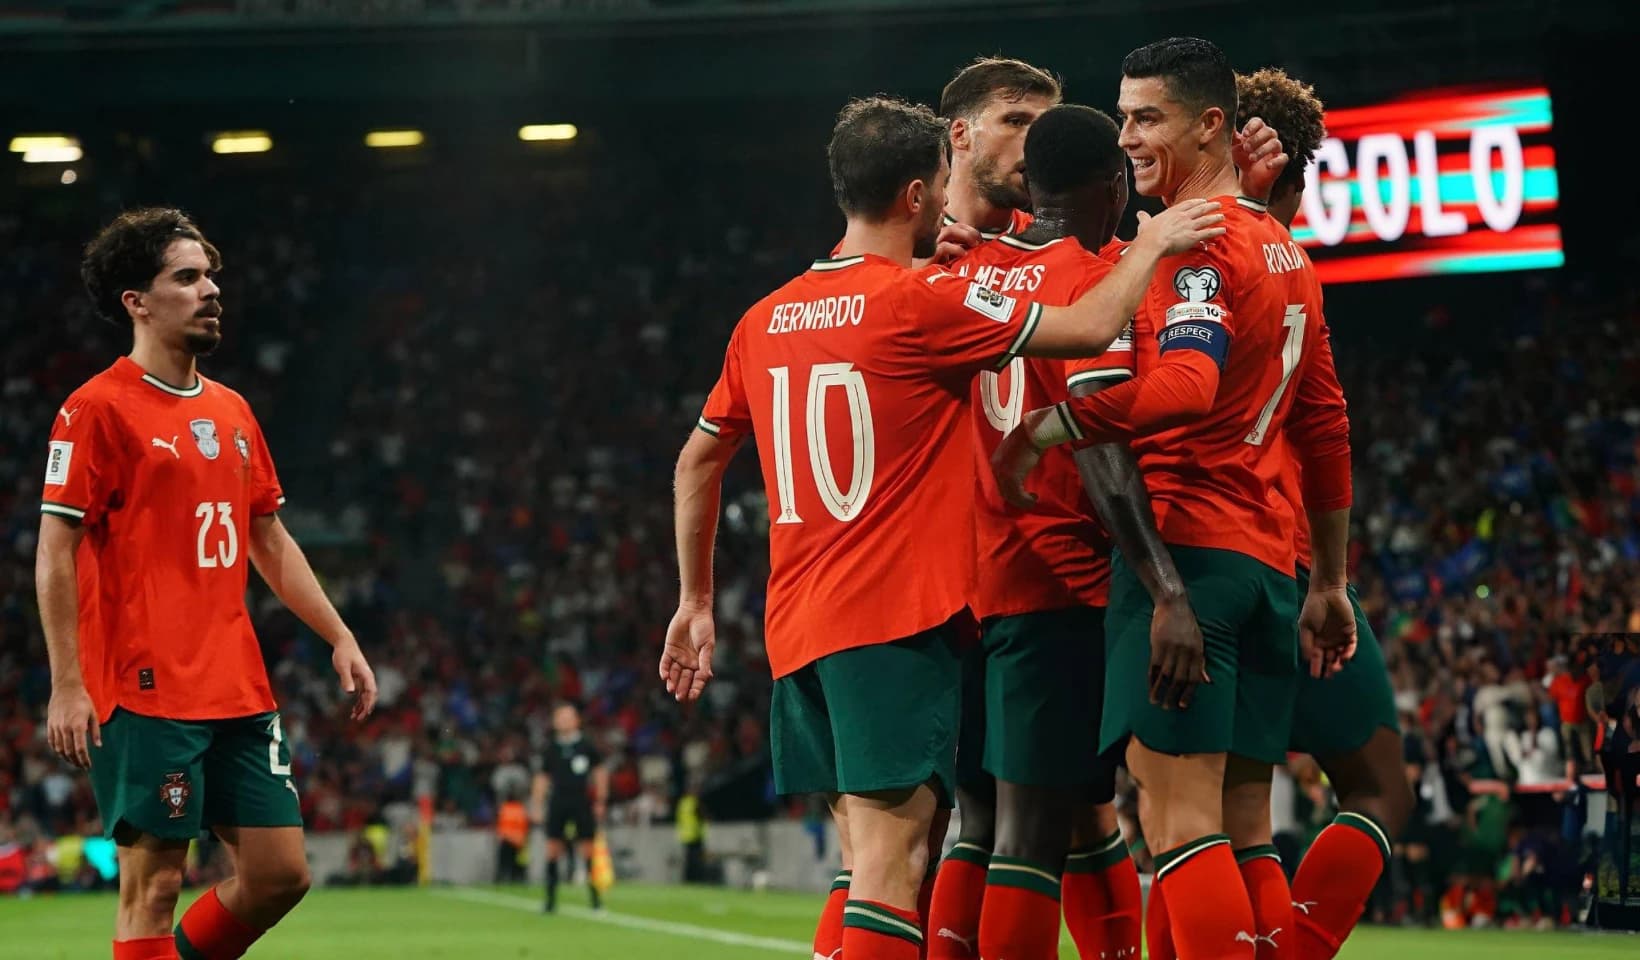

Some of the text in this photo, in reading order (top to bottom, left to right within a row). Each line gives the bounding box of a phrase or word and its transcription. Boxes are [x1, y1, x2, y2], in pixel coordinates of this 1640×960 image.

[1305, 126, 1524, 246] GOLO
[975, 265, 1045, 292] MEDES
[767, 294, 865, 334] BERNARDO
[1168, 327, 1212, 340] RESPECT
[767, 362, 875, 524] 10
[195, 502, 239, 568] 23
